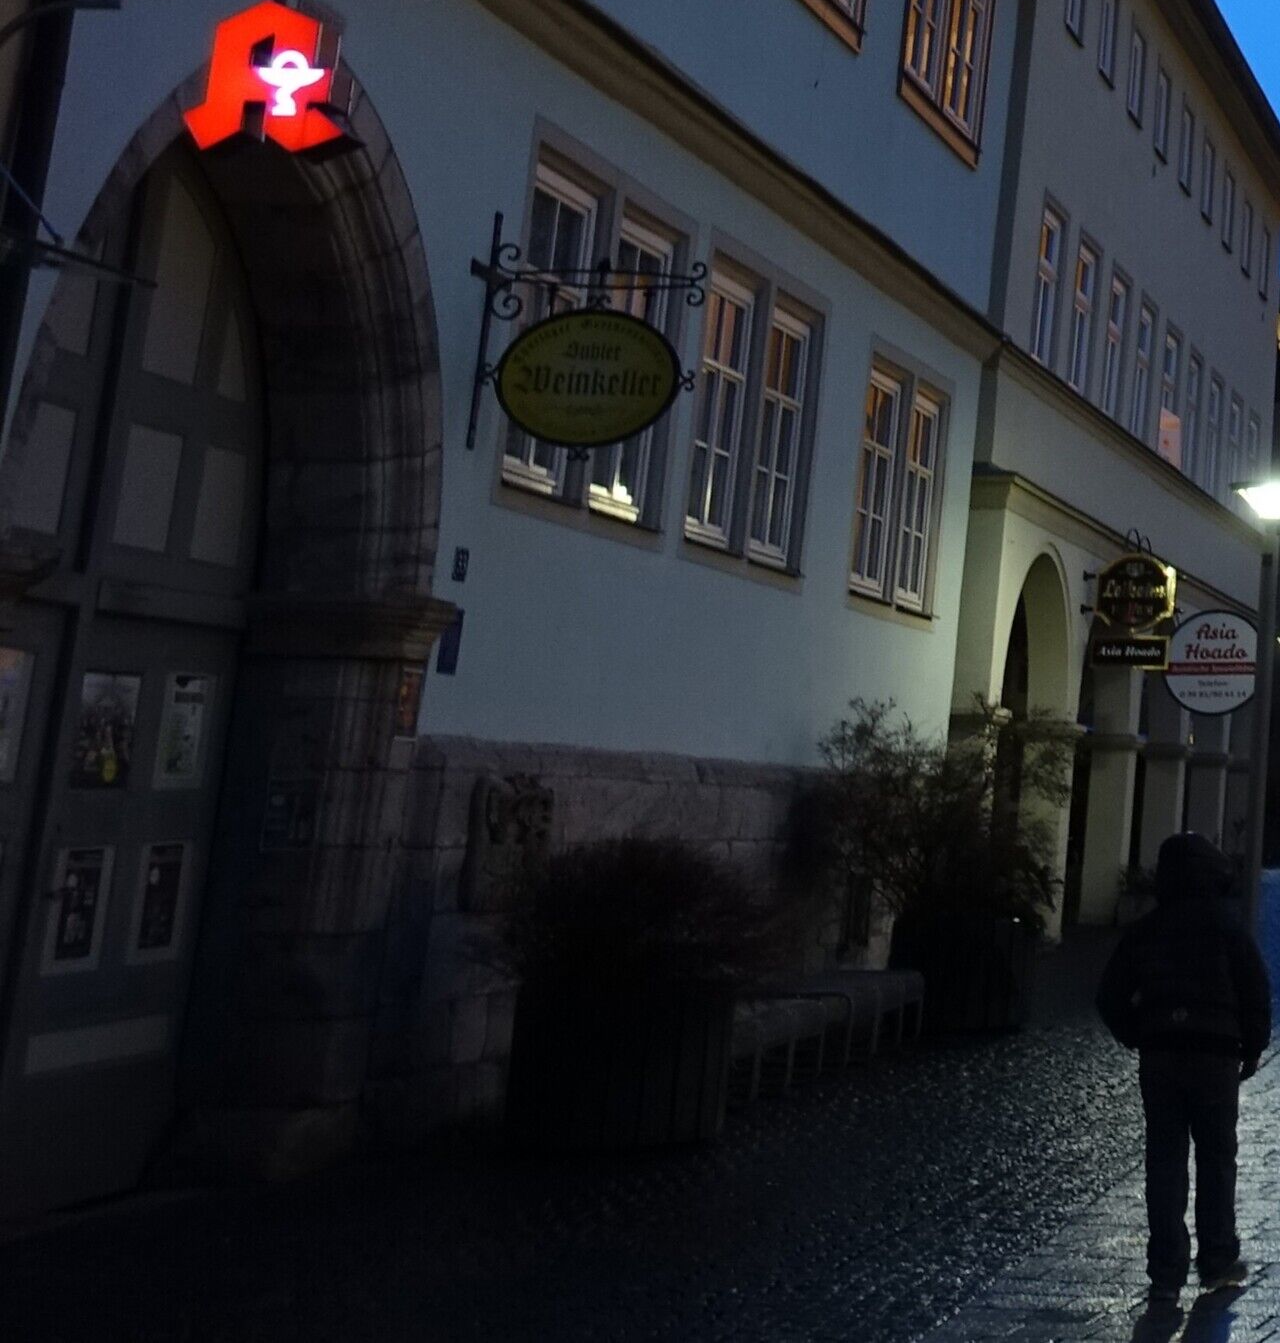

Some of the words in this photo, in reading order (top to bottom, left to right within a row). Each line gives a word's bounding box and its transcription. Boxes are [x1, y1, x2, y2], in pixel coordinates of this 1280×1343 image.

[513, 364, 662, 397] Weinkeller
[1197, 622, 1239, 640] Asia
[1186, 643, 1248, 660] Hoado
